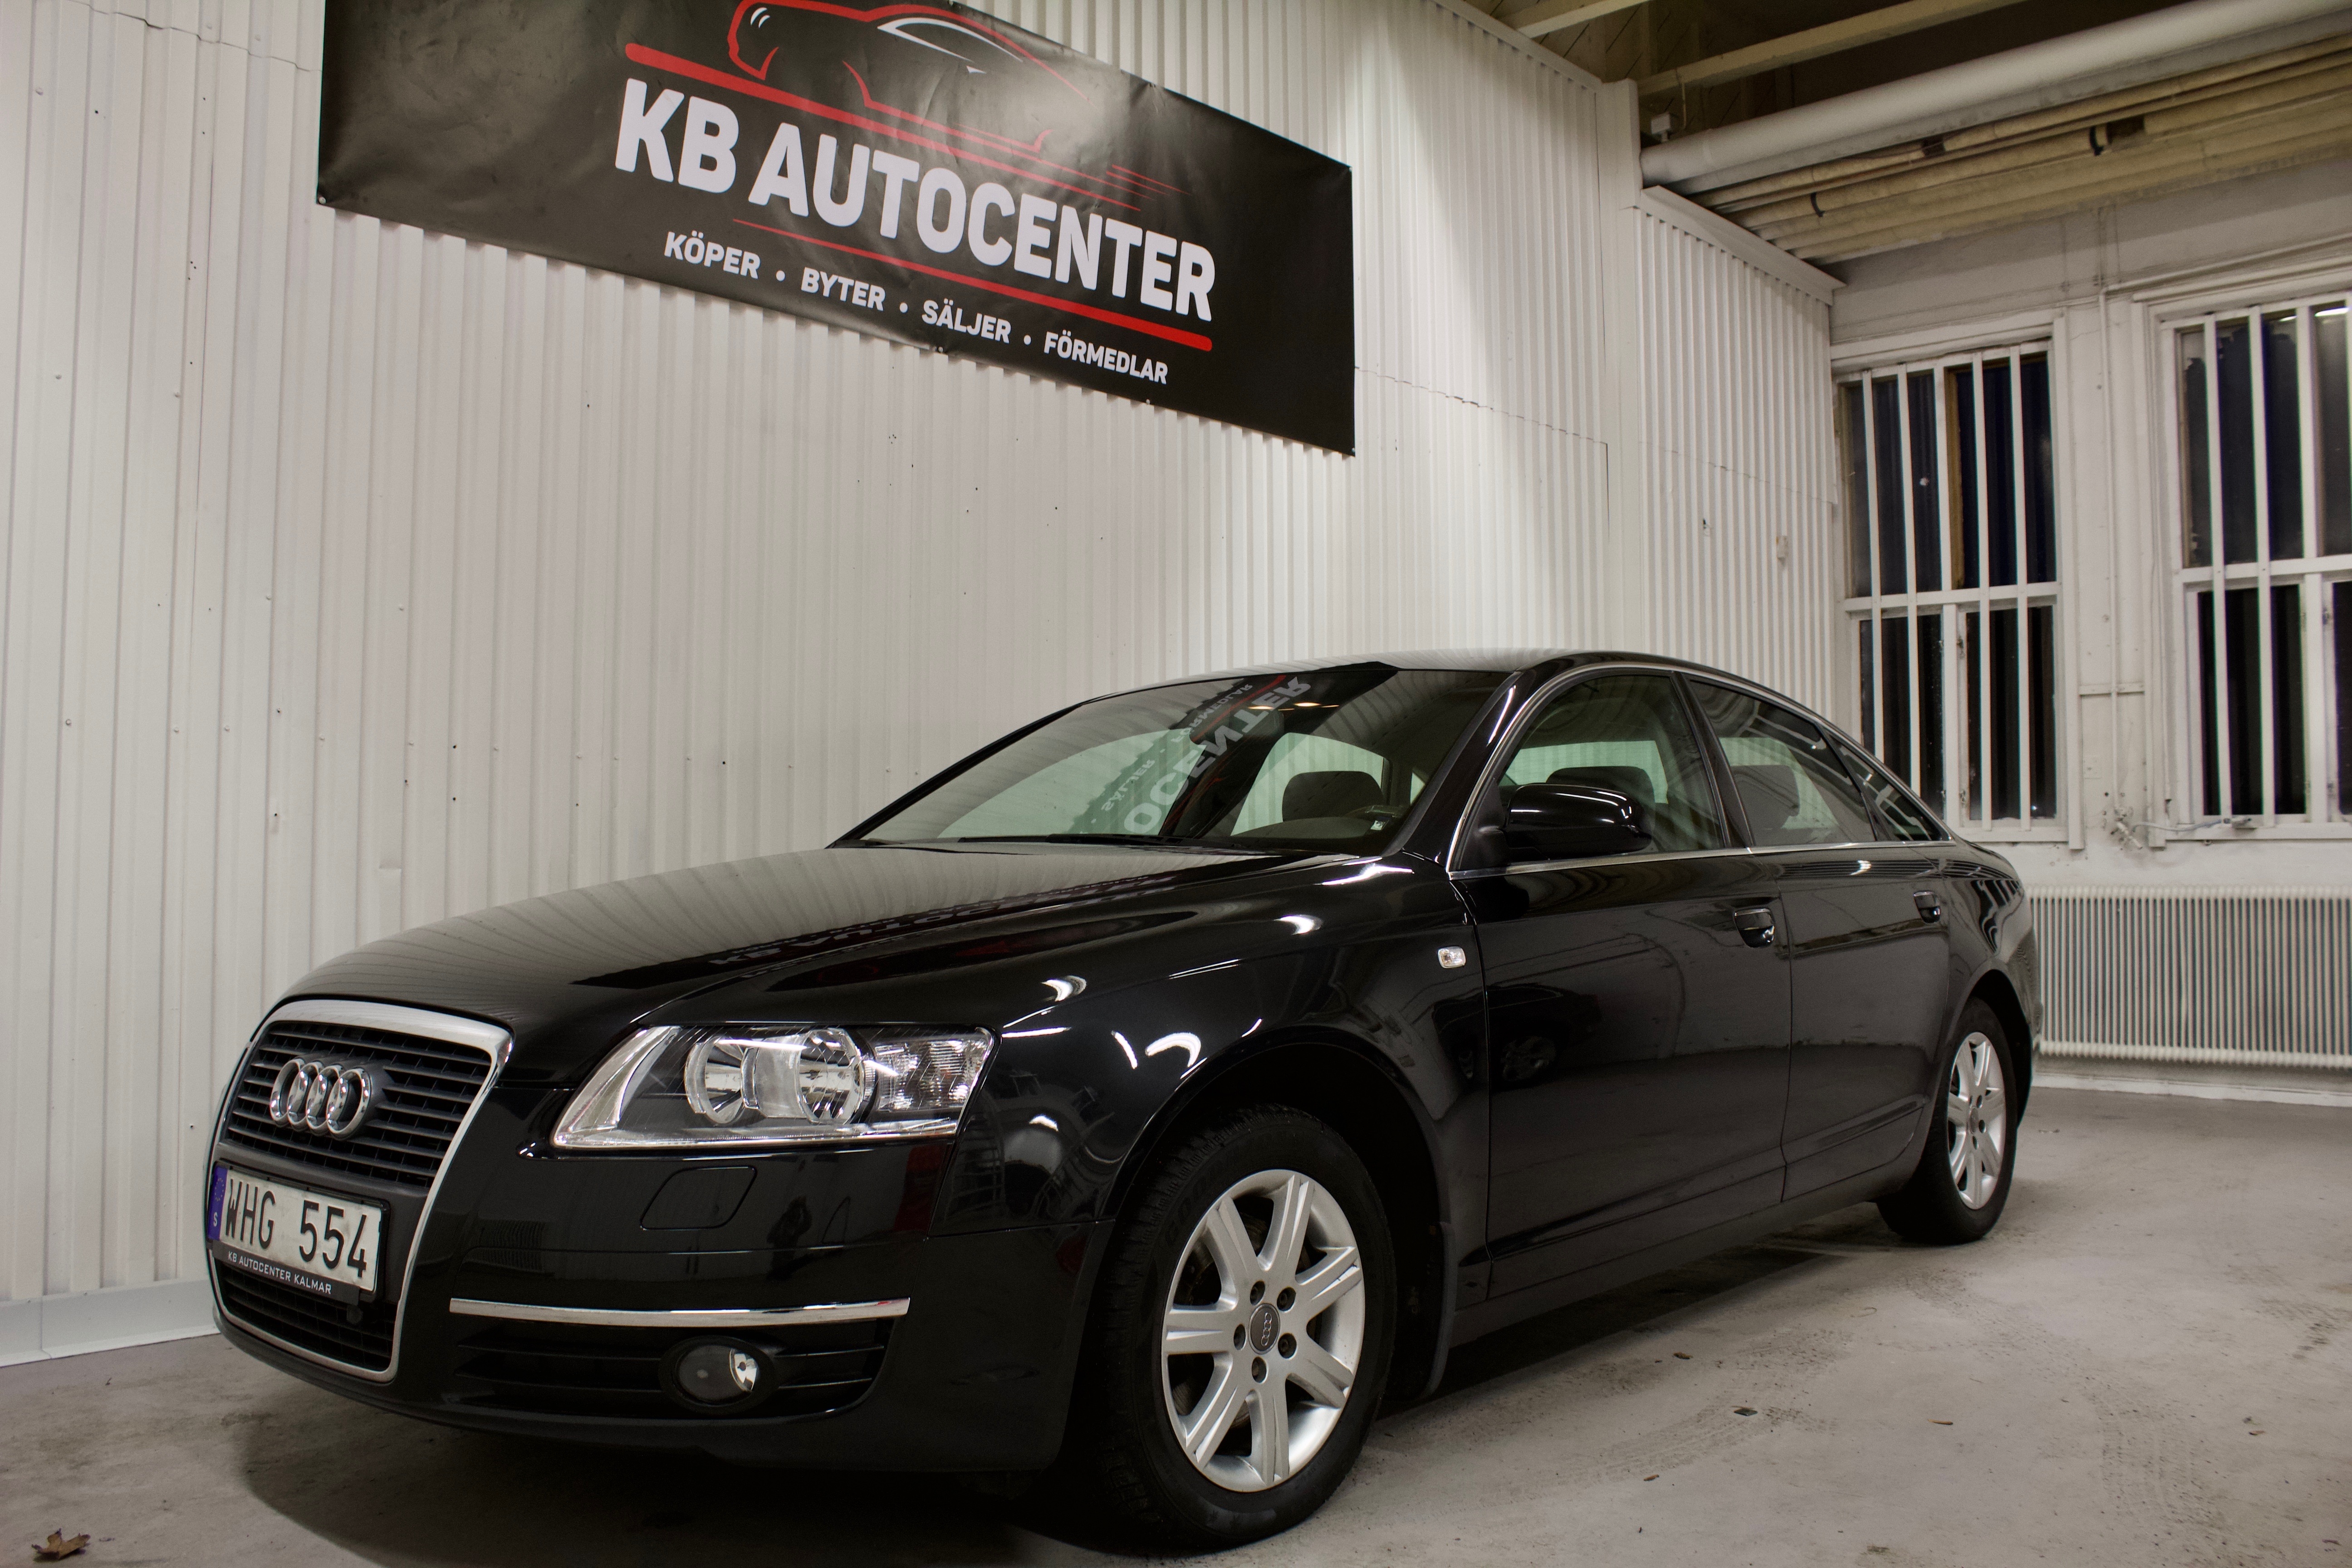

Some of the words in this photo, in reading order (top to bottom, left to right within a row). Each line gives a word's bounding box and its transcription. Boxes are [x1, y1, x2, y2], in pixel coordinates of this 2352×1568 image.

[615, 78, 740, 194] KB
[748, 122, 1215, 322] AUTOCENTER
[664, 230, 761, 279] KÖPER
[801, 267, 886, 312] BYTER
[921, 298, 1012, 344] SÄLJER
[1044, 329, 1168, 385] FÖRMEDLAR
[213, 1212, 219, 1227] S
[225, 1178, 276, 1250] WHG
[299, 1199, 368, 1279] 554
[228, 1250, 238, 1263] KB
[238, 1255, 291, 1282] AUTOCENTER
[294, 1273, 332, 1295] KALMAR
